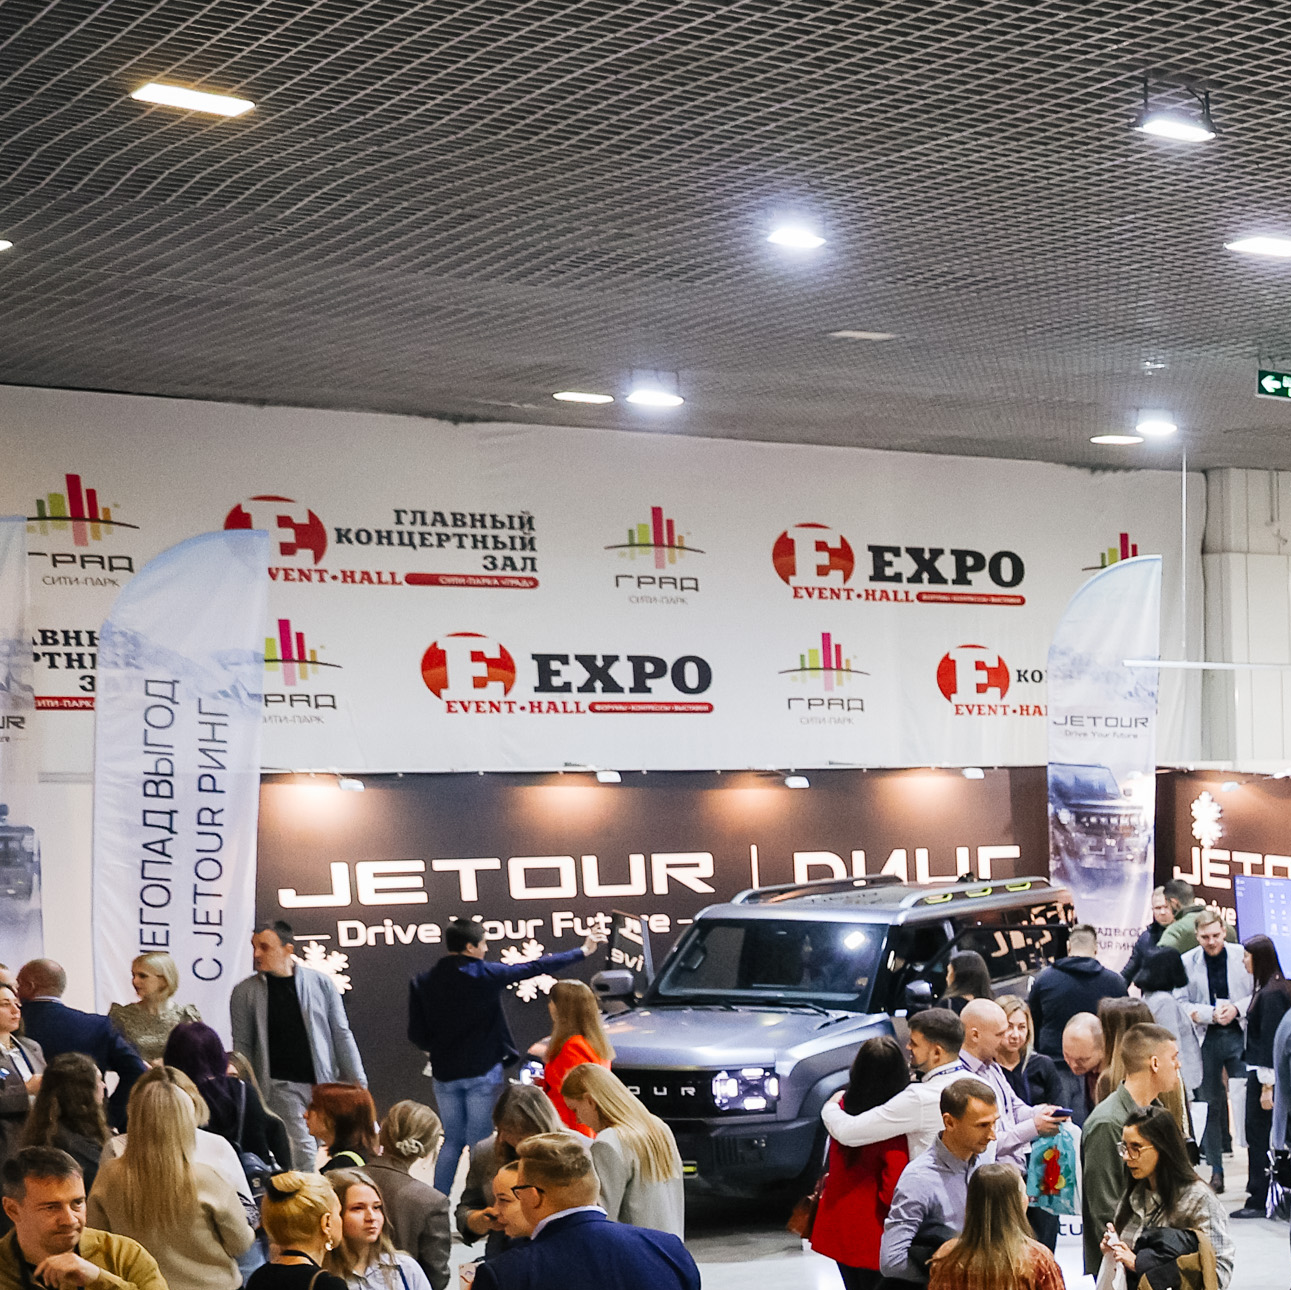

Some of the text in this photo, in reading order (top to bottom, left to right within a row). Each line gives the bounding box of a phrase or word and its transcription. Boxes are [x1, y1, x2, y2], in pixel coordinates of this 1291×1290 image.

[393, 508, 536, 532] ГЛАВНЫЙ
[334, 527, 538, 552] КОНЦЕРТНЫЙ
[482, 555, 538, 572] ЗАЛ
[867, 544, 1025, 588] EXPO
[614, 574, 700, 592] ГРАД
[531, 653, 713, 695] EXPO
[264, 694, 337, 710] РАД
[787, 697, 865, 712] ГРАД
[262, 714, 326, 725] ИТИ-ПАРК
[1052, 715, 1149, 729] JETOUR
[143, 679, 180, 799] ВЫГОД
[197, 698, 229, 794] РИНГ
[192, 807, 225, 947] JETOUR
[277, 851, 716, 909] JETOUR
[336, 918, 443, 948] Drive
